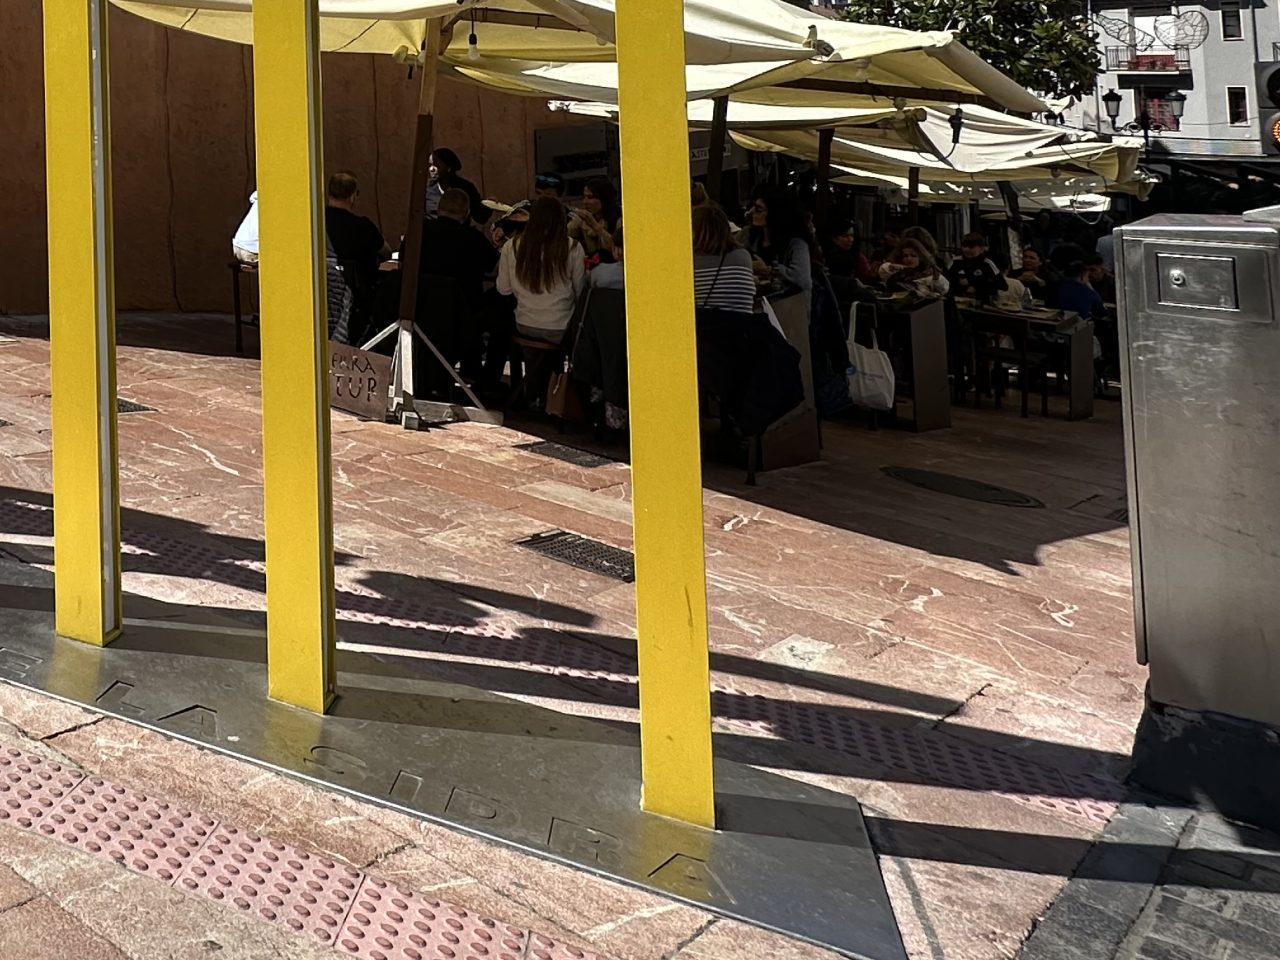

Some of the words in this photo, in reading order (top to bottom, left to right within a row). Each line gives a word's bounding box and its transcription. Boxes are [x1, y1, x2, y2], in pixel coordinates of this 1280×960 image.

[332, 373, 377, 402] TUR
[95, 680, 221, 742] LA
[302, 744, 738, 906] SIDRA
